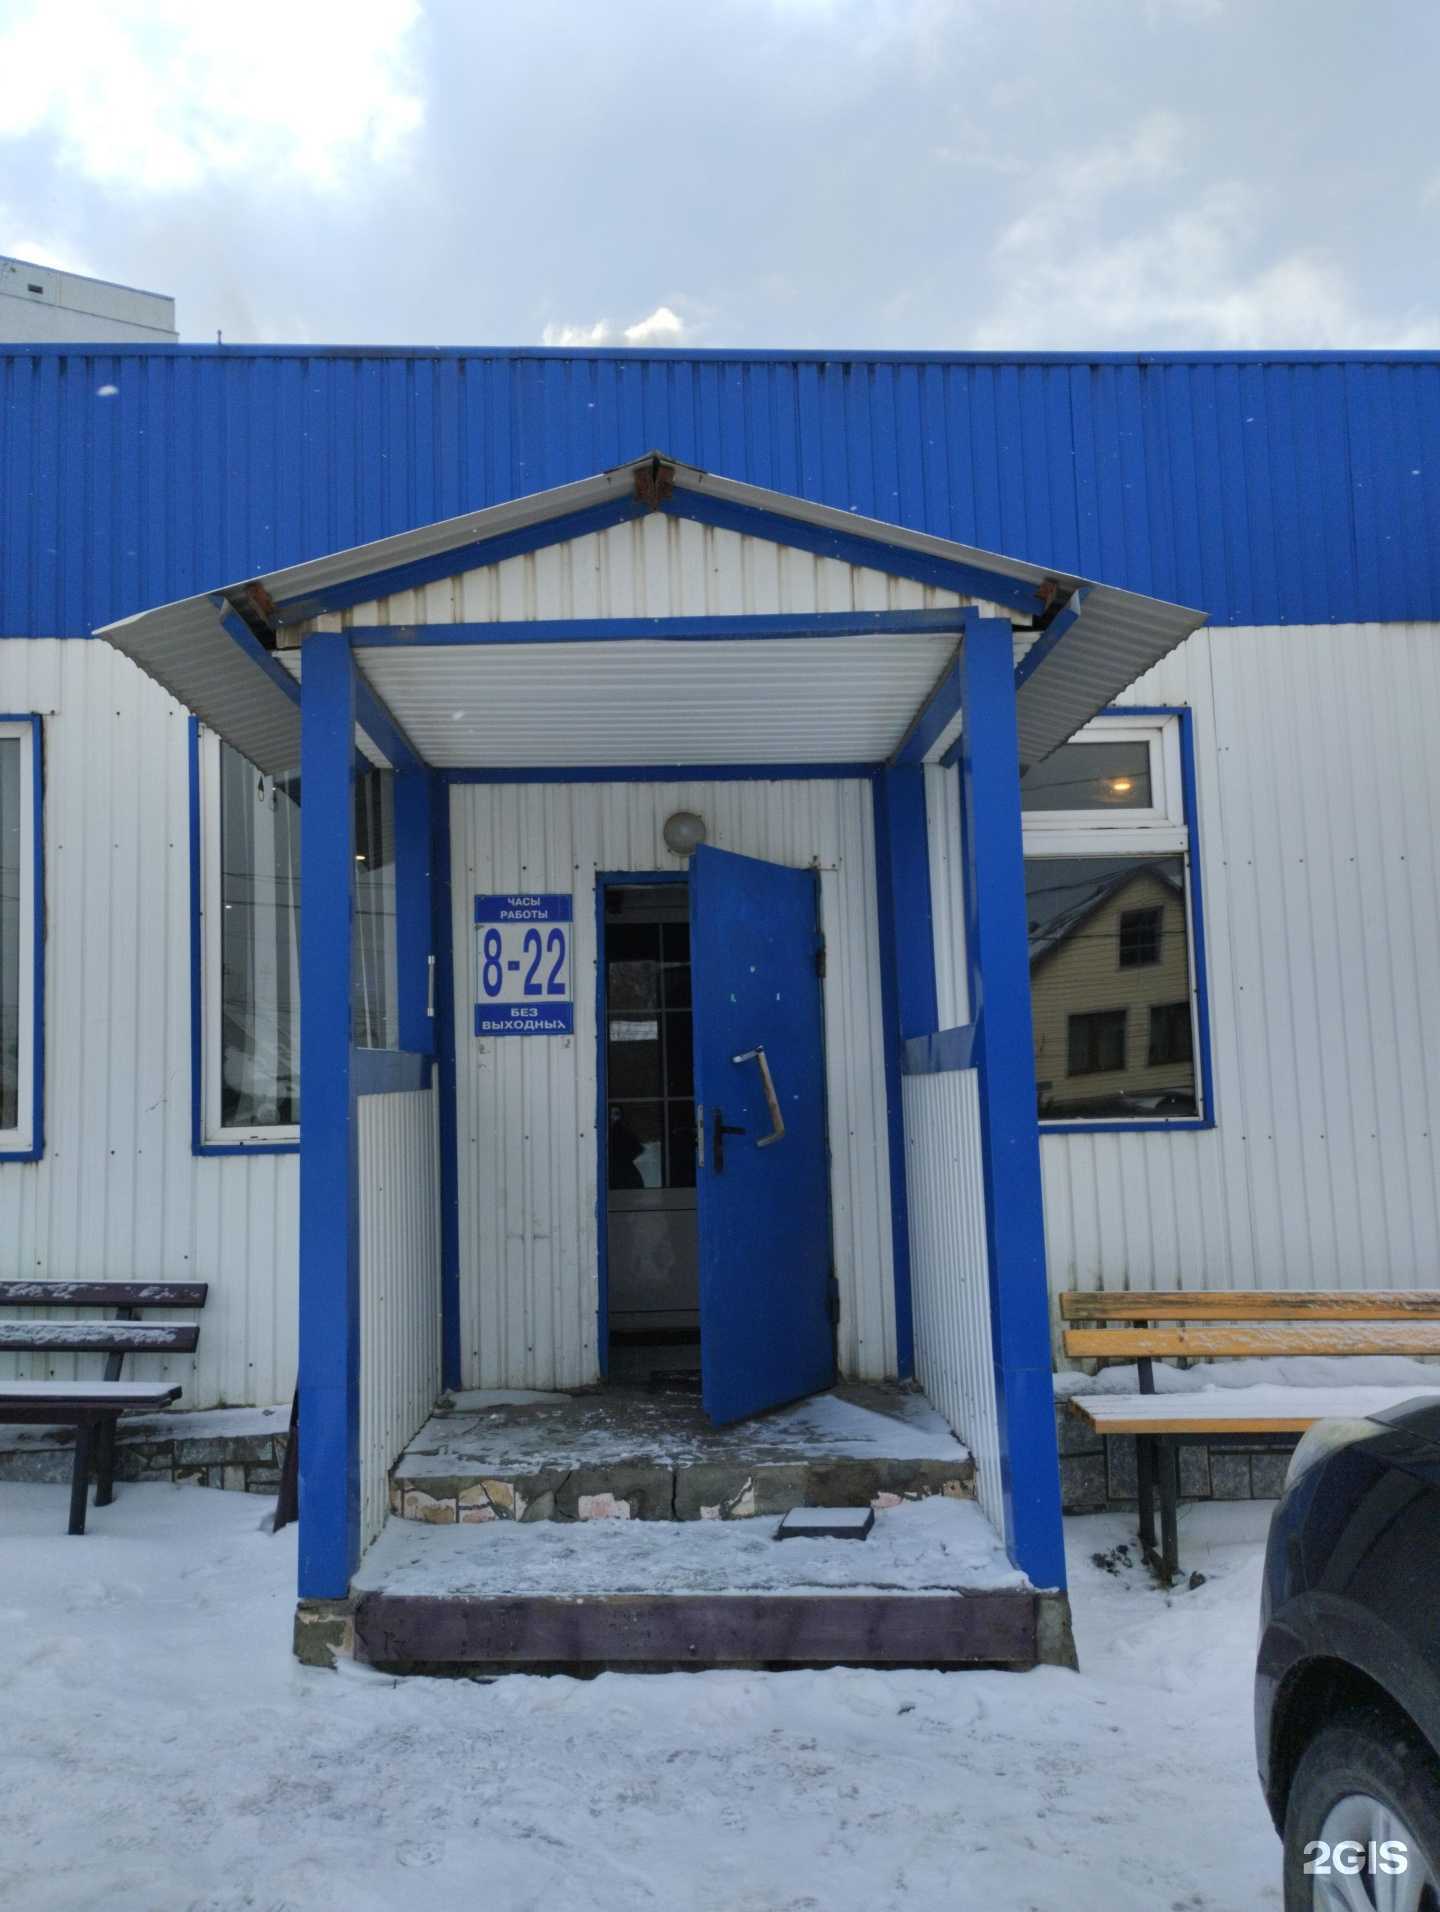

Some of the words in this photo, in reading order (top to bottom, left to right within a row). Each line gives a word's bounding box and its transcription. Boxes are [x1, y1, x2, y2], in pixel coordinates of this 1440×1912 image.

[507, 897, 541, 907] ЧАСЫ
[500, 910, 548, 920] РАБОТЫ
[482, 928, 566, 997] 8-22
[510, 1007, 539, 1017] БЕЗ
[482, 1019, 566, 1031] ВЫХОДНЫХ
